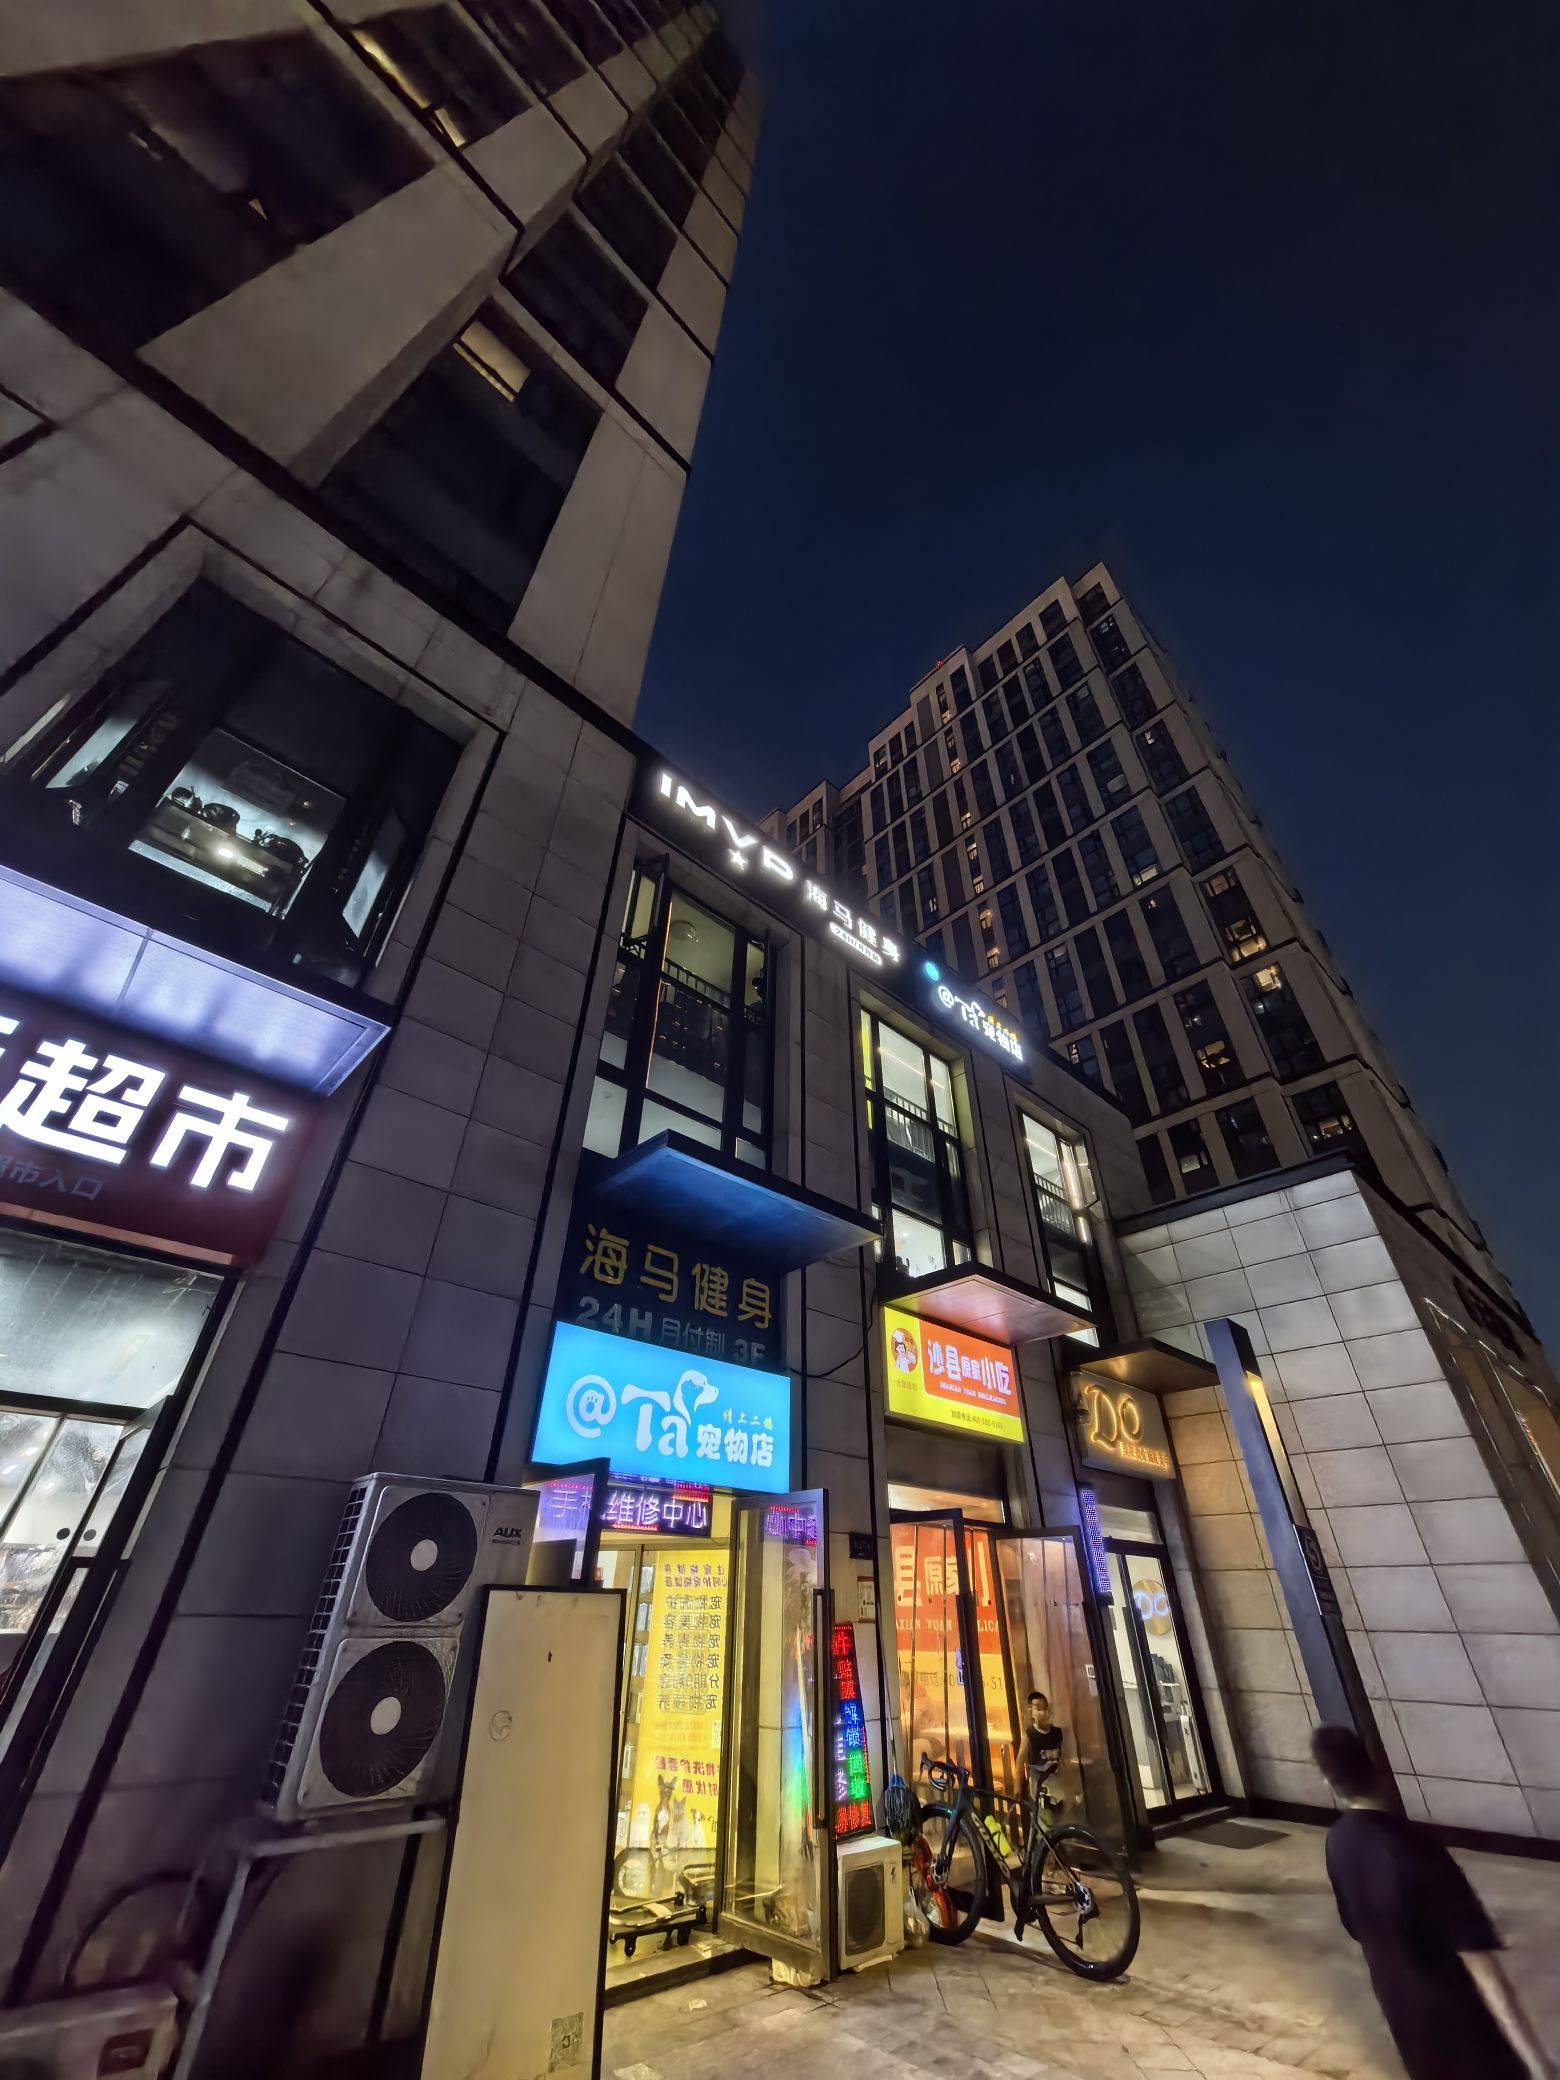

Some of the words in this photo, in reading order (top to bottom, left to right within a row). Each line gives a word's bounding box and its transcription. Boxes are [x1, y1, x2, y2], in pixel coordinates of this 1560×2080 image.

[806, 879, 900, 963] 海马健身
[0, 1017, 289, 1193] 超市
[579, 1223, 772, 1329] 海马健身
[575, 1296, 653, 1341] 24H
[696, 1423, 774, 1468] 宠物店
[1085, 1385, 1143, 1452] DO
[493, 1526, 522, 1538] AUX
